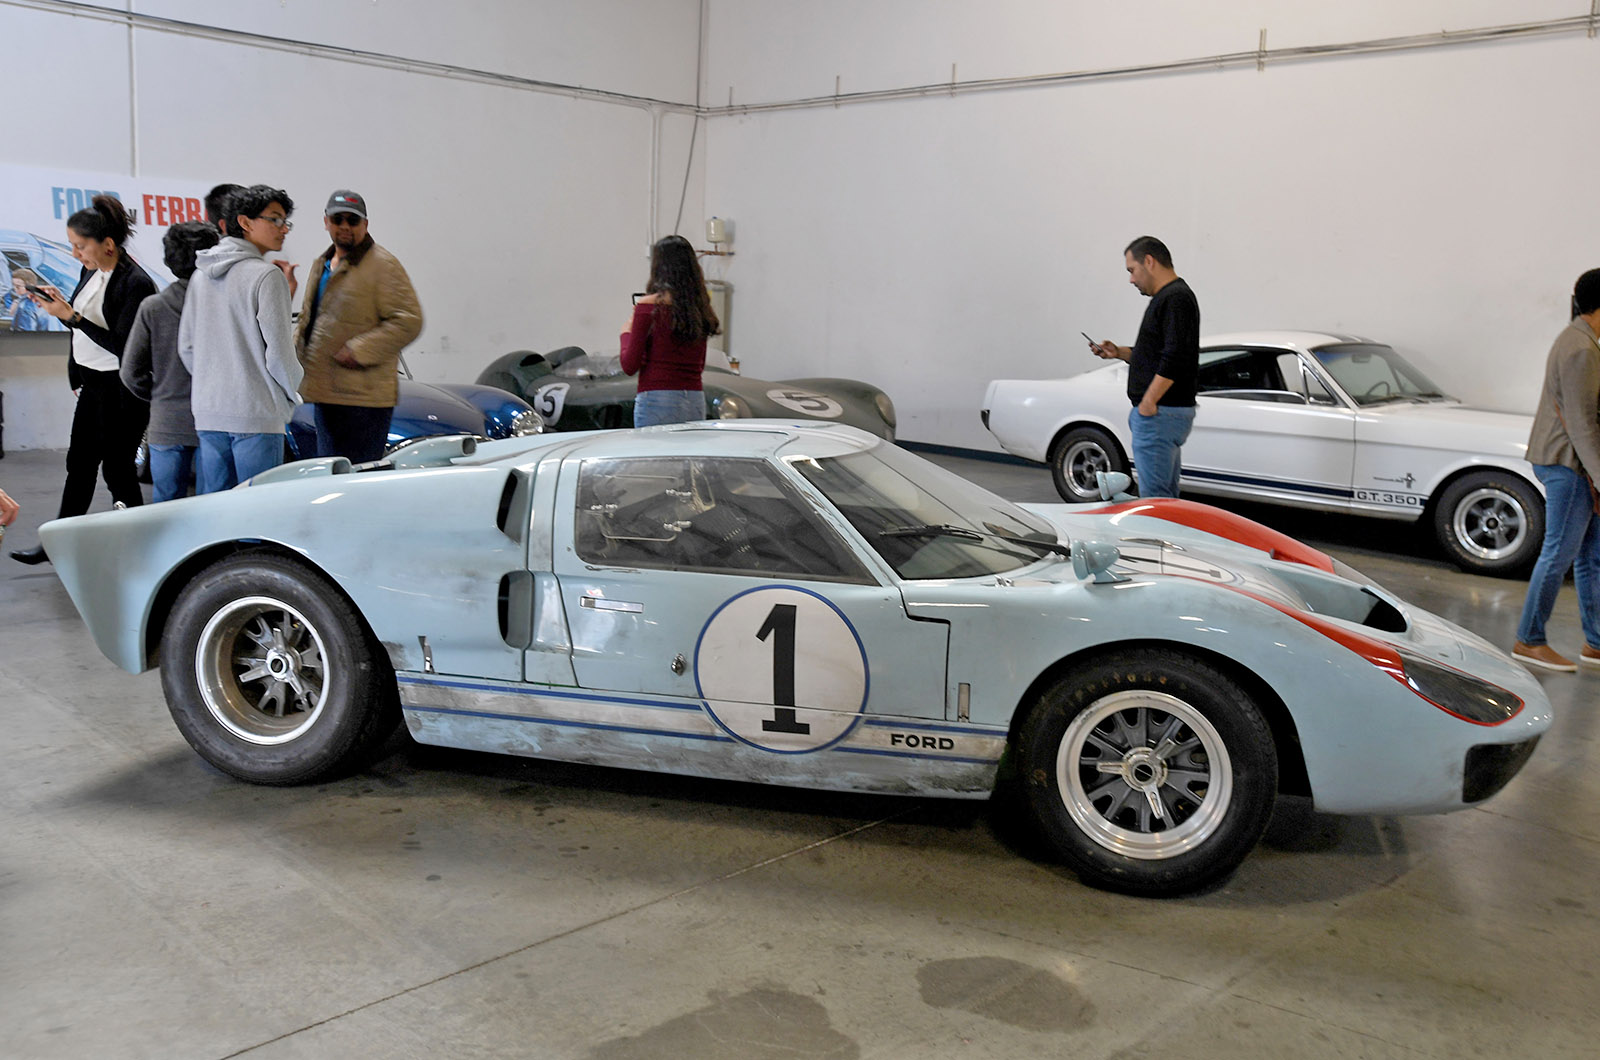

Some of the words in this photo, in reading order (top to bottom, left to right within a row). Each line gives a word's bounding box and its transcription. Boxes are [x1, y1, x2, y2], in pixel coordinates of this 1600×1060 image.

[143, 194, 208, 226] FERR
[542, 386, 565, 418] 5
[782, 391, 830, 411] 5
[756, 603, 811, 735] 1
[890, 733, 955, 750] FORD
